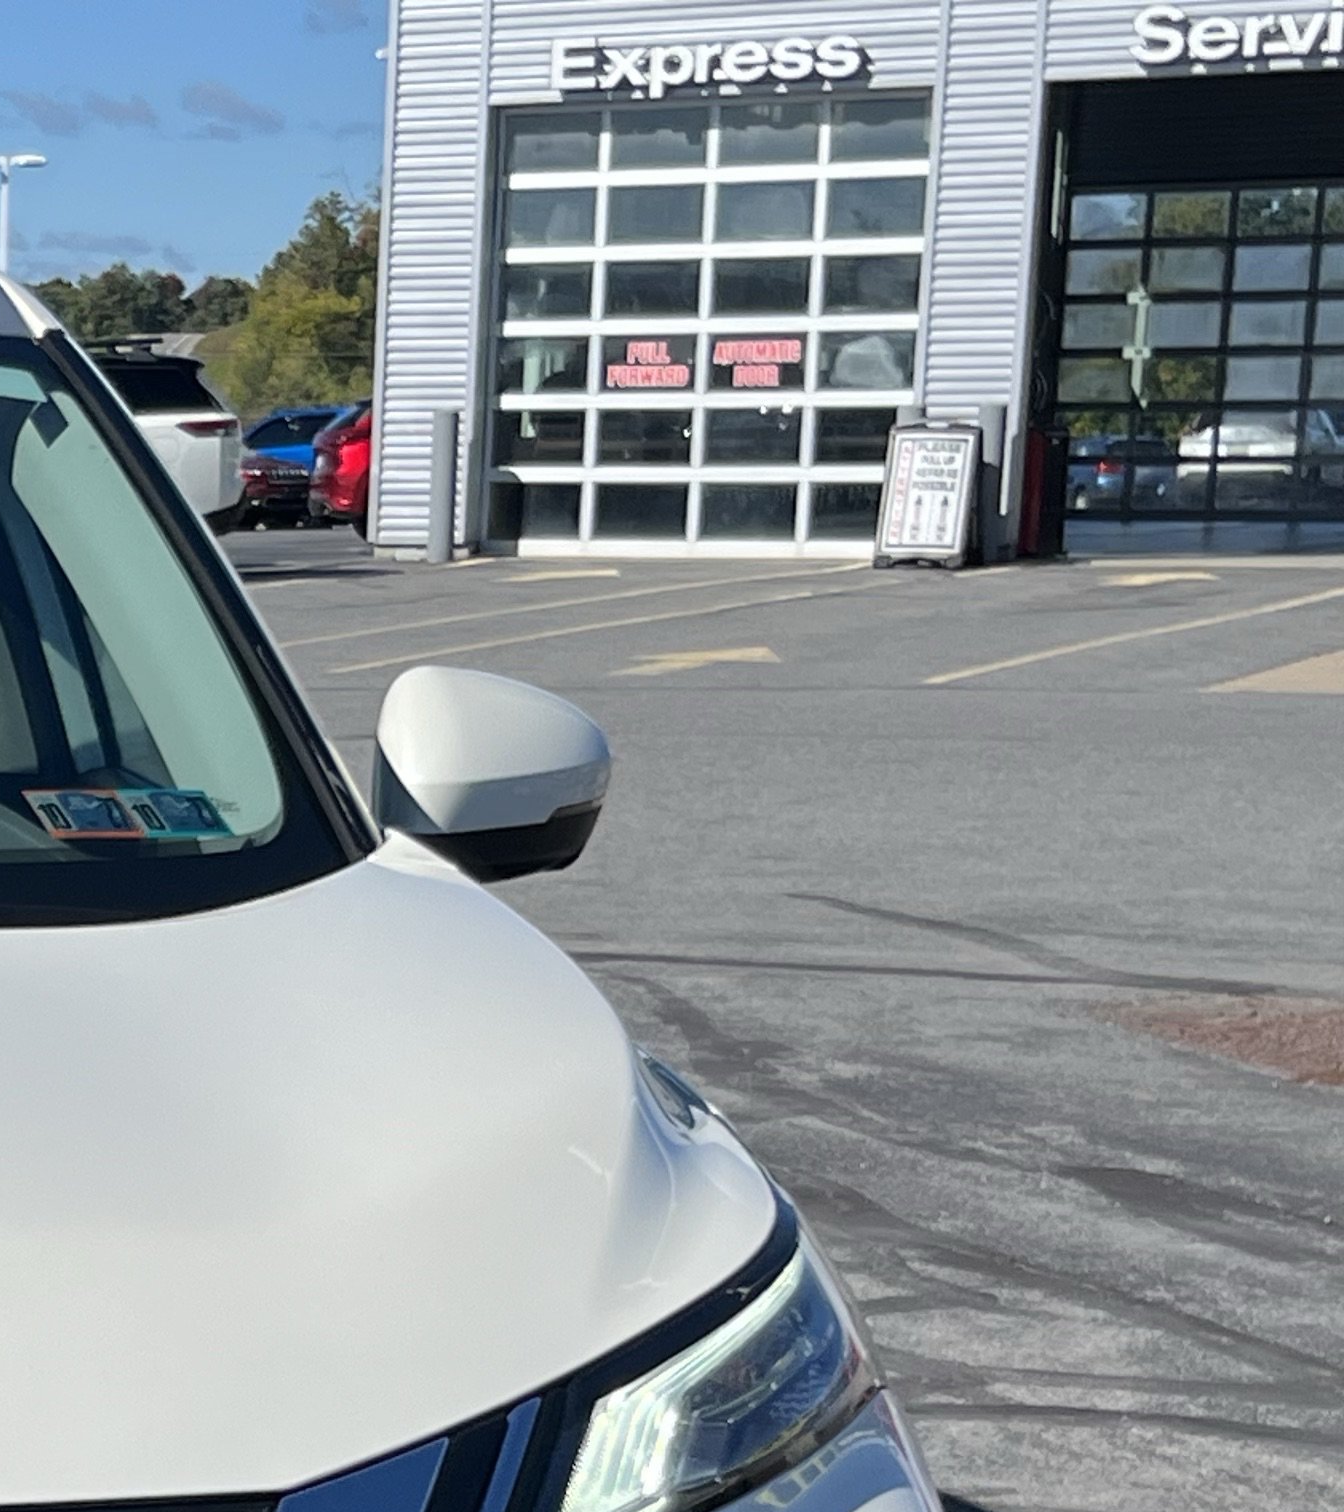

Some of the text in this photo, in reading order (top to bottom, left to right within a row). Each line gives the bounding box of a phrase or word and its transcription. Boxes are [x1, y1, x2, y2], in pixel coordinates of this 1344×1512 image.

[1129, 0, 1343, 64] Servi
[551, 35, 862, 99] Express
[607, 365, 689, 387] FORWARD
